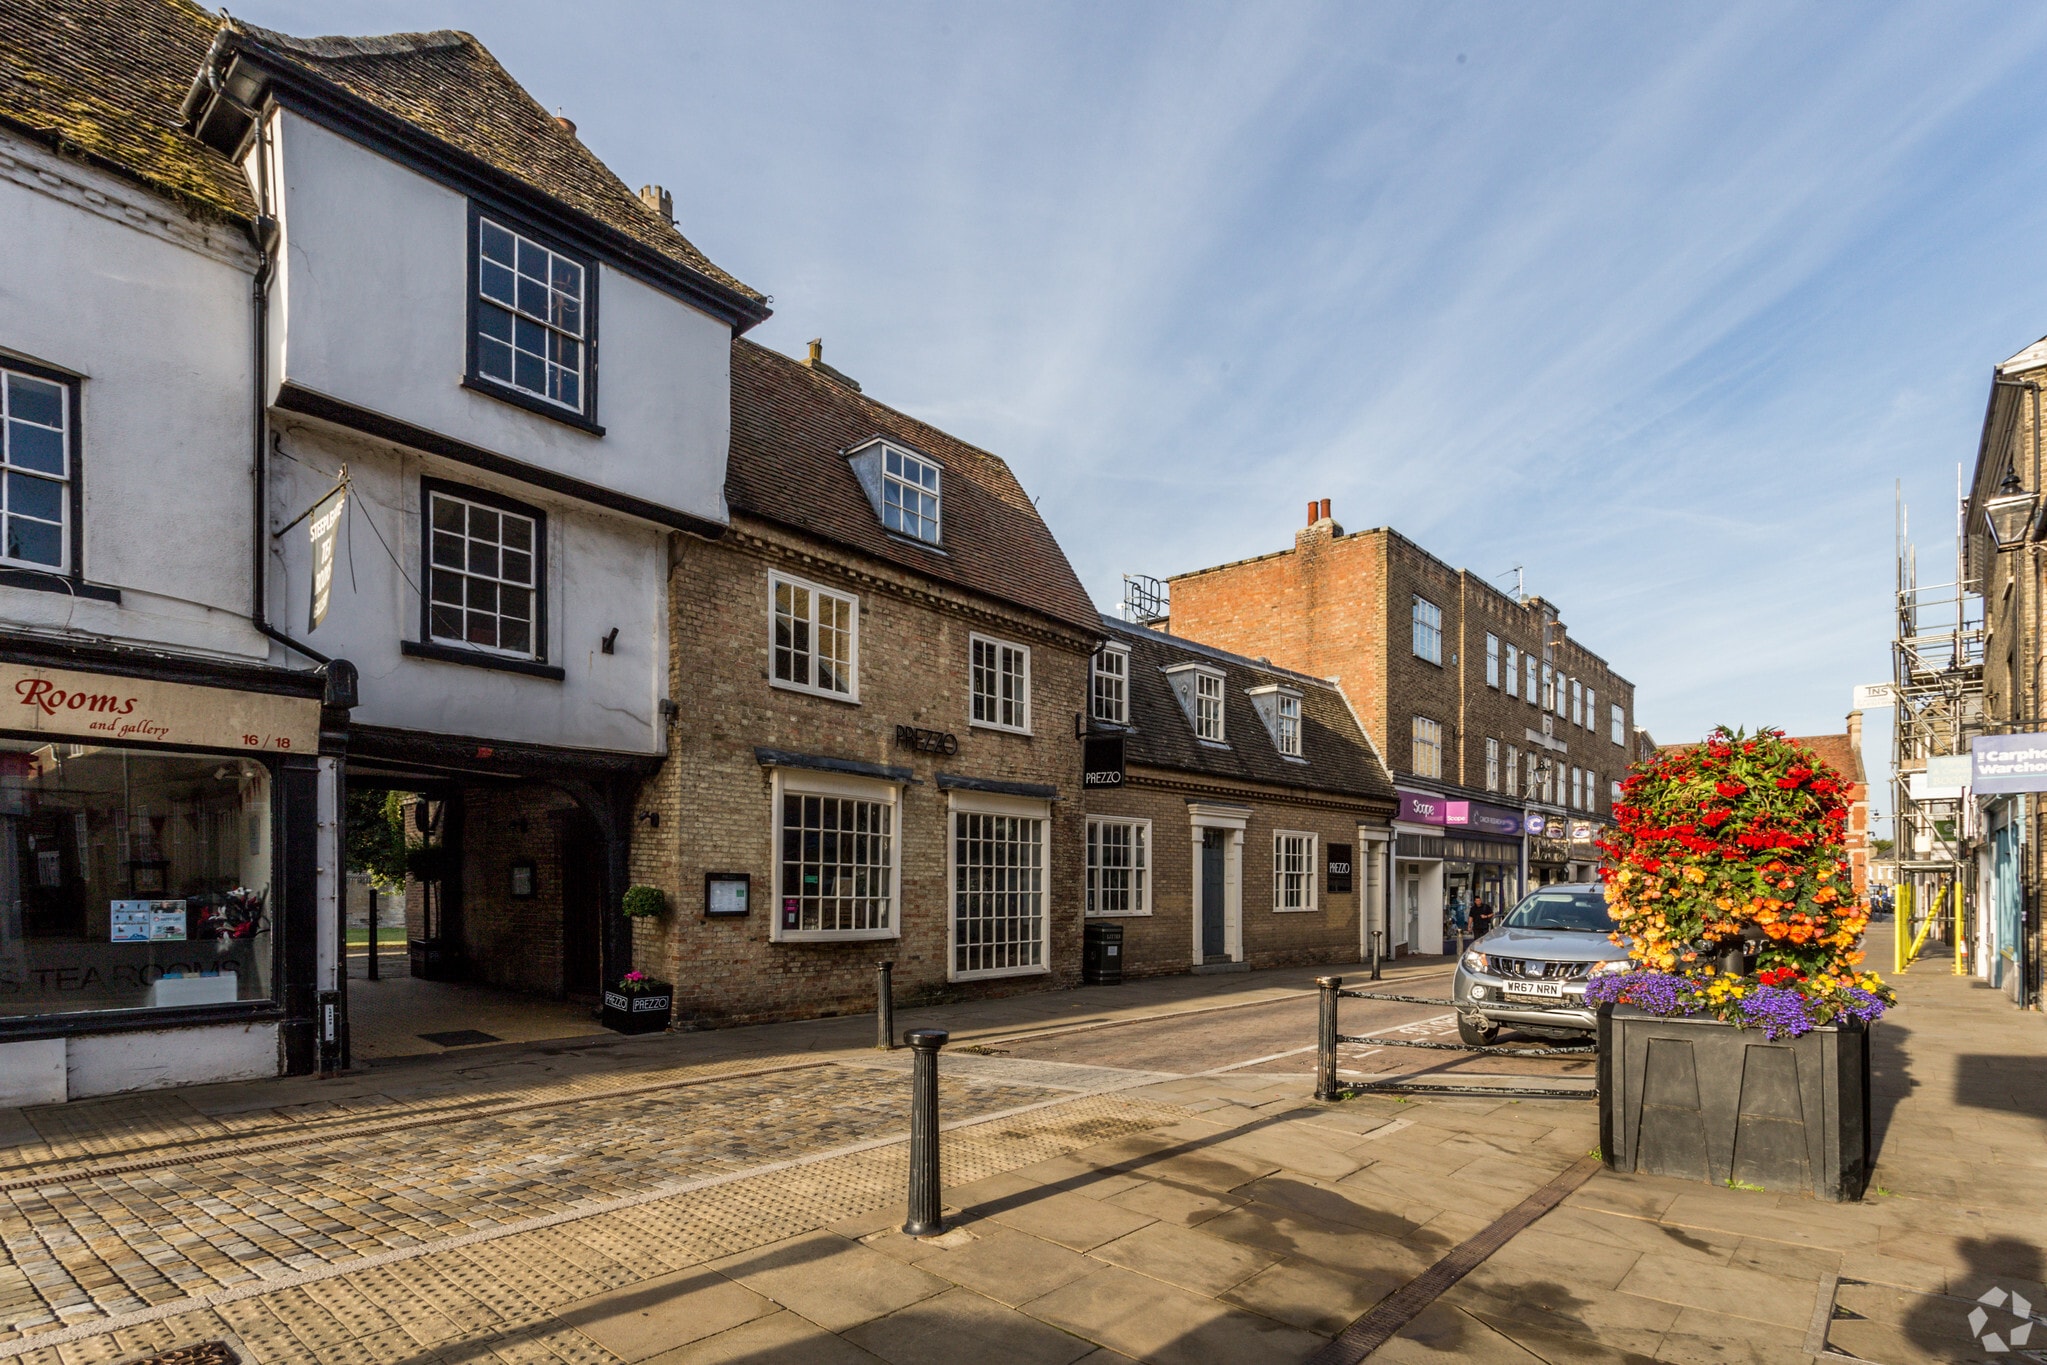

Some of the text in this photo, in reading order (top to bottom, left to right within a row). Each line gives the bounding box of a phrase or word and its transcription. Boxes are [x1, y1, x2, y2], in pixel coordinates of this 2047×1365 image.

[15, 678, 138, 716] Rooms
[89, 717, 169, 741] and gallery
[242, 734, 259, 746] 16
[275, 737, 291, 749] 18
[896, 724, 958, 756] PREZZO
[1978, 761, 2047, 775] Wareho
[1086, 771, 1121, 784] PREZZO
[1413, 800, 1435, 817] Scope
[1447, 815, 1466, 823] Scope
[1329, 862, 1350, 874] PREZZO
[1507, 982, 1558, 995] WR67 NRN
[605, 993, 626, 1008] PREZZO
[635, 998, 667, 1010] PREZZO
